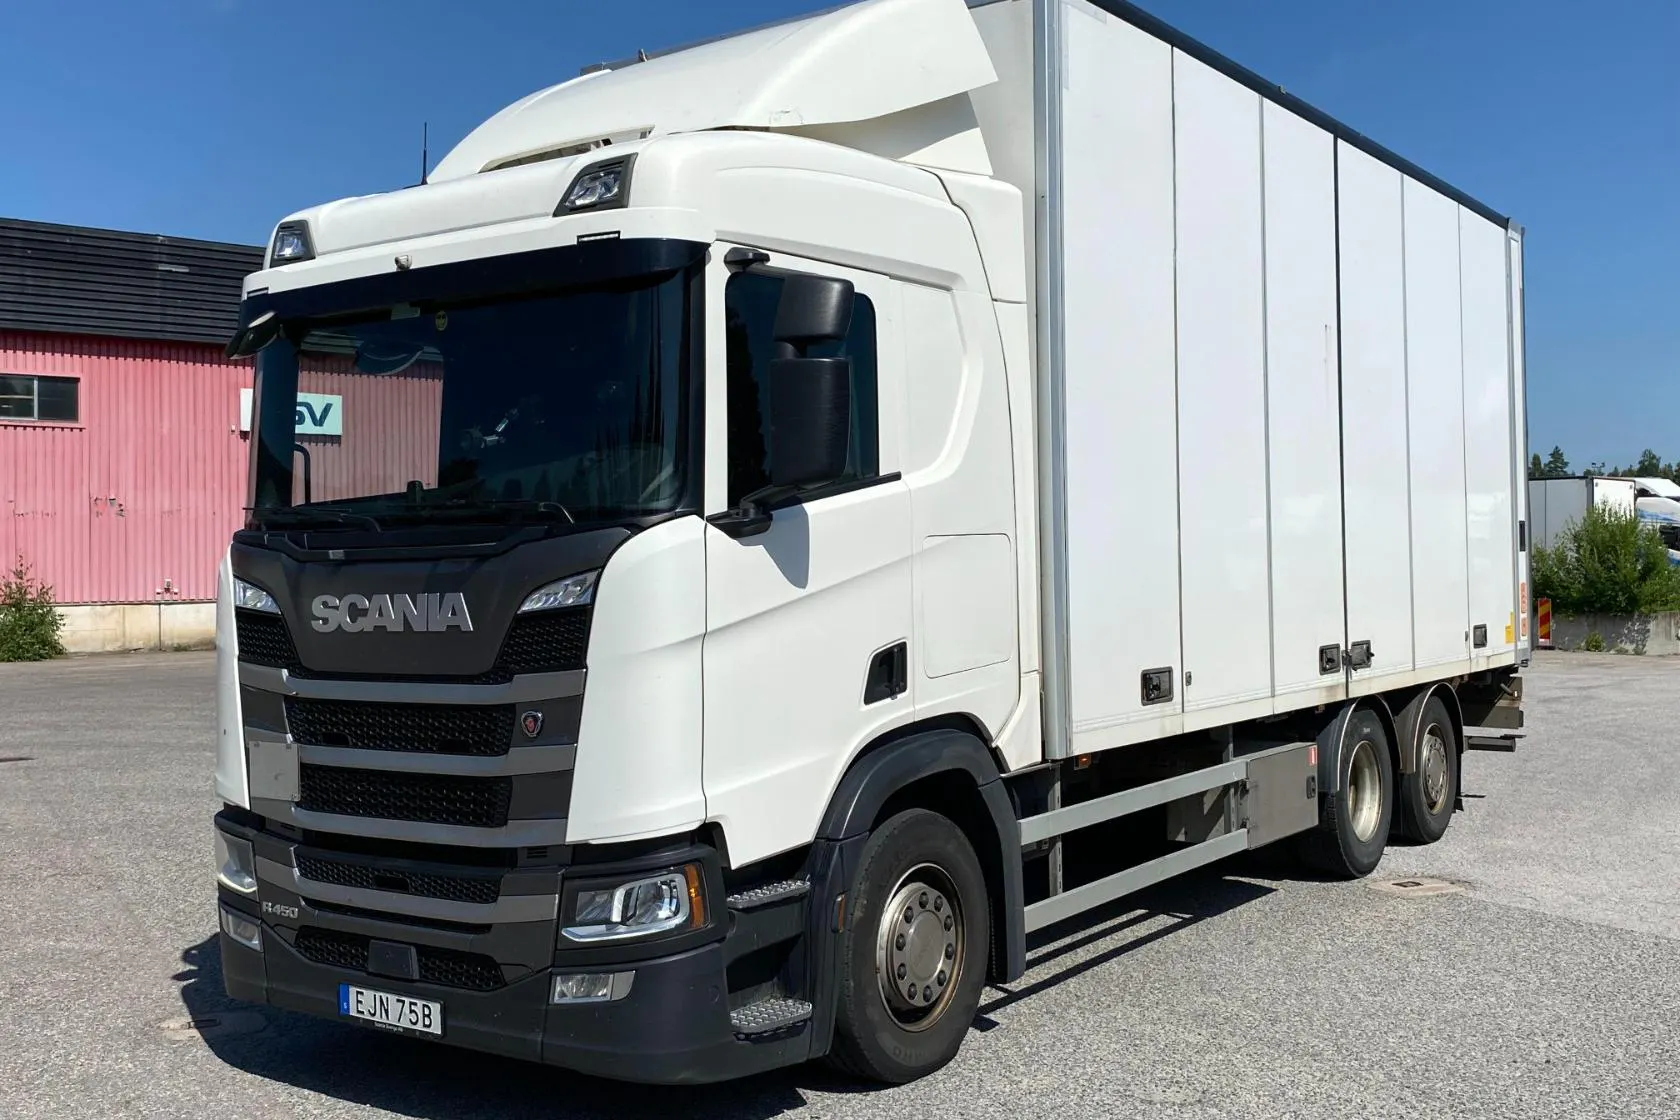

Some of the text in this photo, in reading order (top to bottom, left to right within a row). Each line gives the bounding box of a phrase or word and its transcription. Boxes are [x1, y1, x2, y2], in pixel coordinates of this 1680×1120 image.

[311, 592, 473, 633] SCANIA
[262, 901, 299, 919] R450
[355, 990, 433, 1029] EJN 75B
